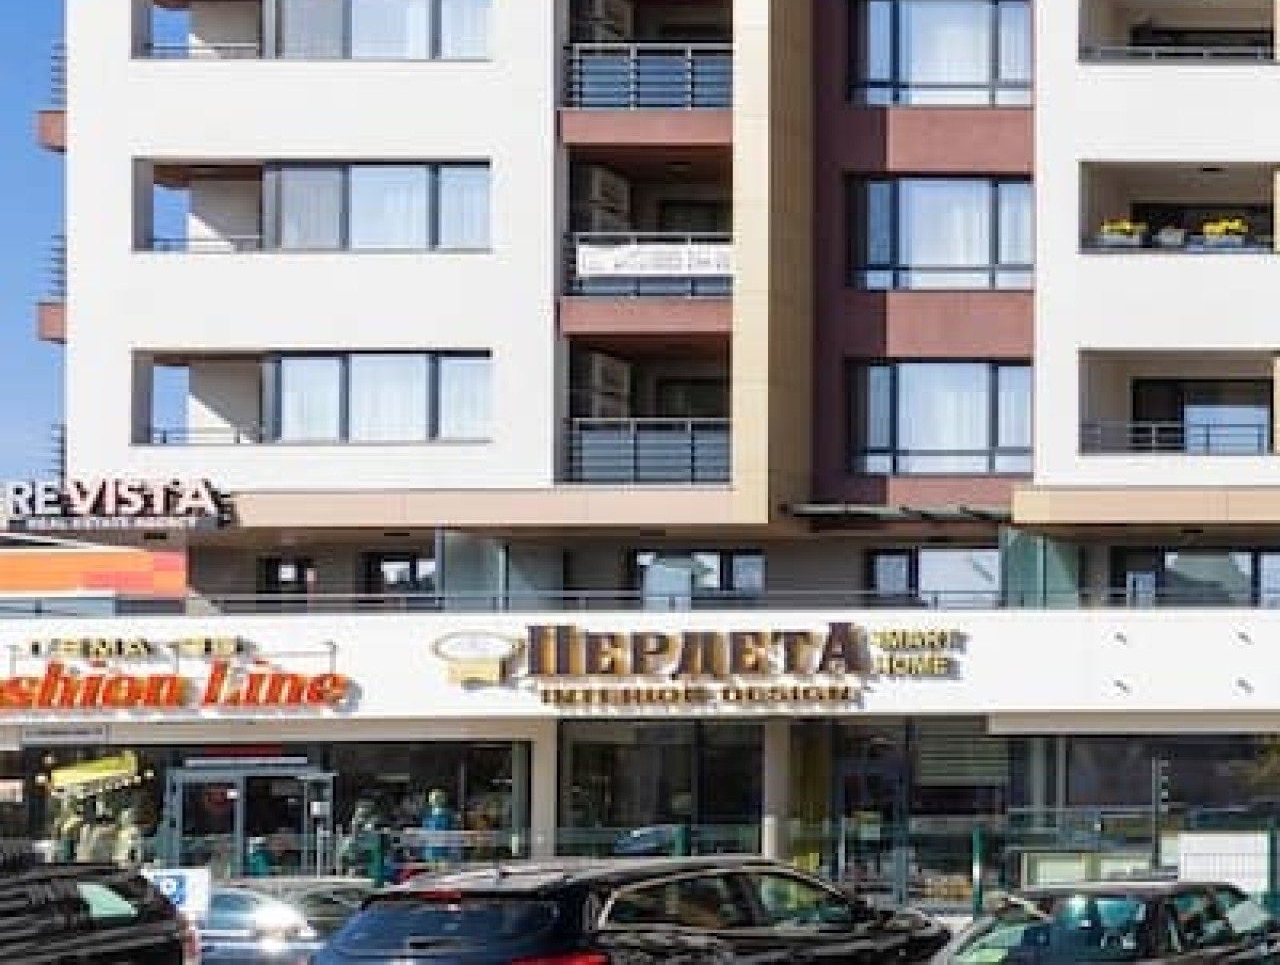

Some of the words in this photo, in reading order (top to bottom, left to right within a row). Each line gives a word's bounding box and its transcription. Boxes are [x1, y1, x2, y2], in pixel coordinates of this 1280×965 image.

[873, 654, 947, 676] HOME
[201, 659, 349, 709] Line
[541, 687, 703, 704] INTERIOR
[719, 685, 852, 703] DESIGN
